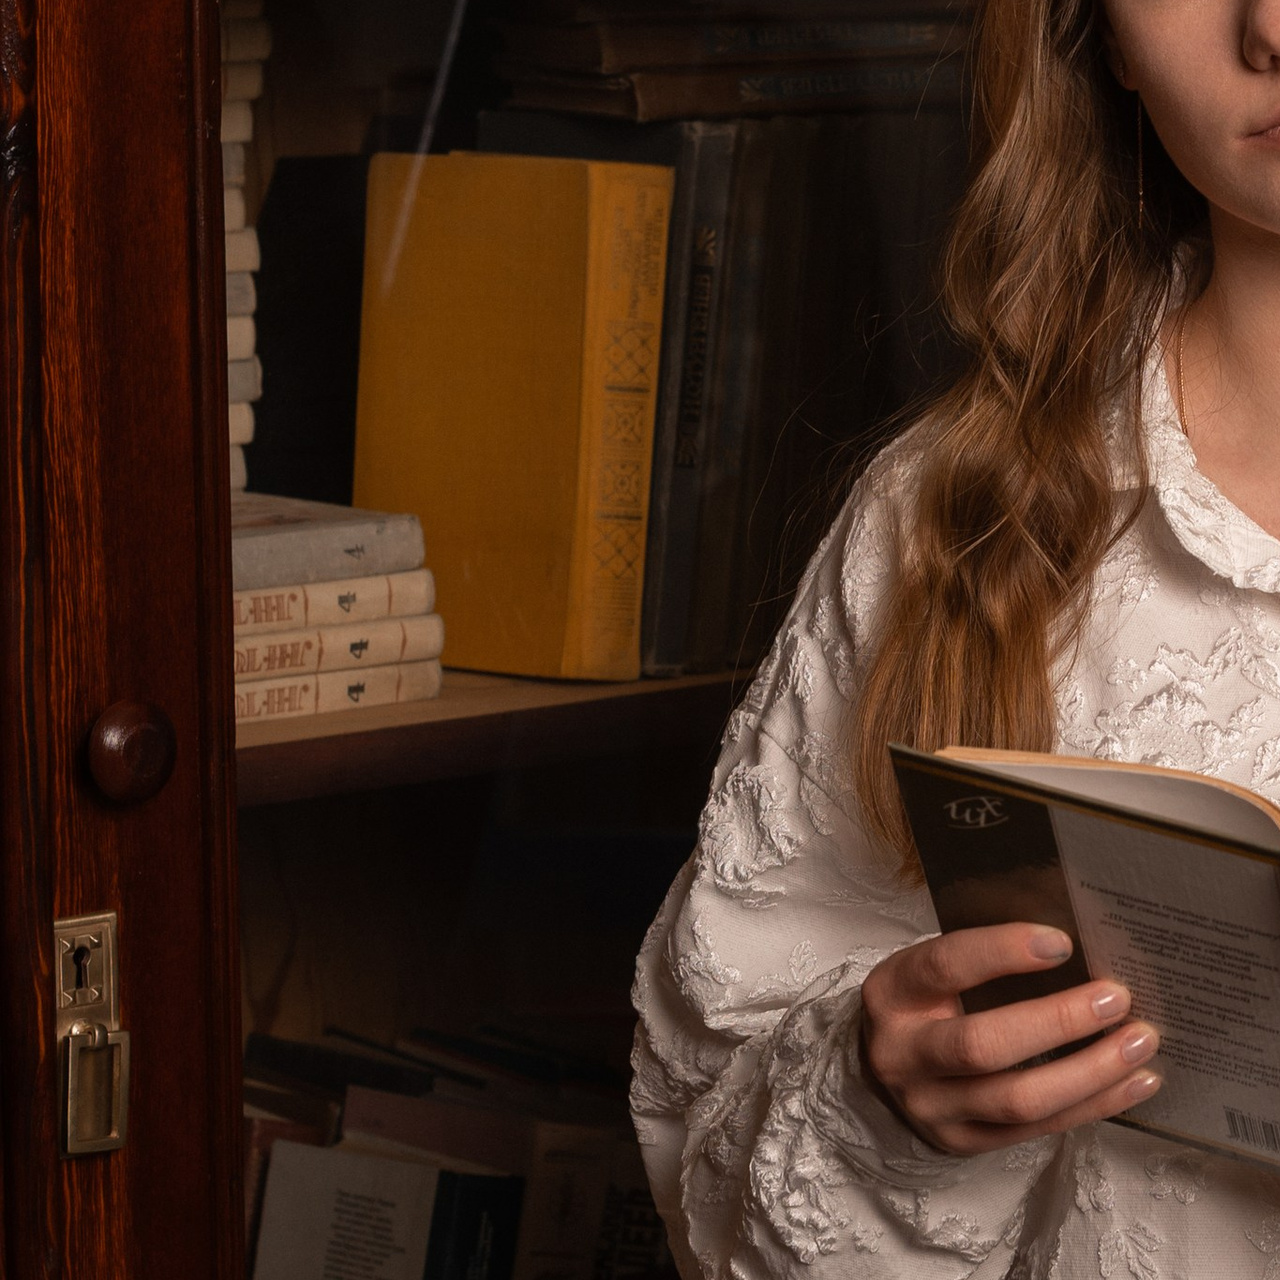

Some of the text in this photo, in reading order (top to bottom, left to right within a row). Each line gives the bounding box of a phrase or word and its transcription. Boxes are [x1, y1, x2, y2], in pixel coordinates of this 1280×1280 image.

[343, 544, 365, 560] 4
[338, 591, 356, 613] 4
[349, 639, 369, 659] 4
[347, 683, 365, 703] 4
